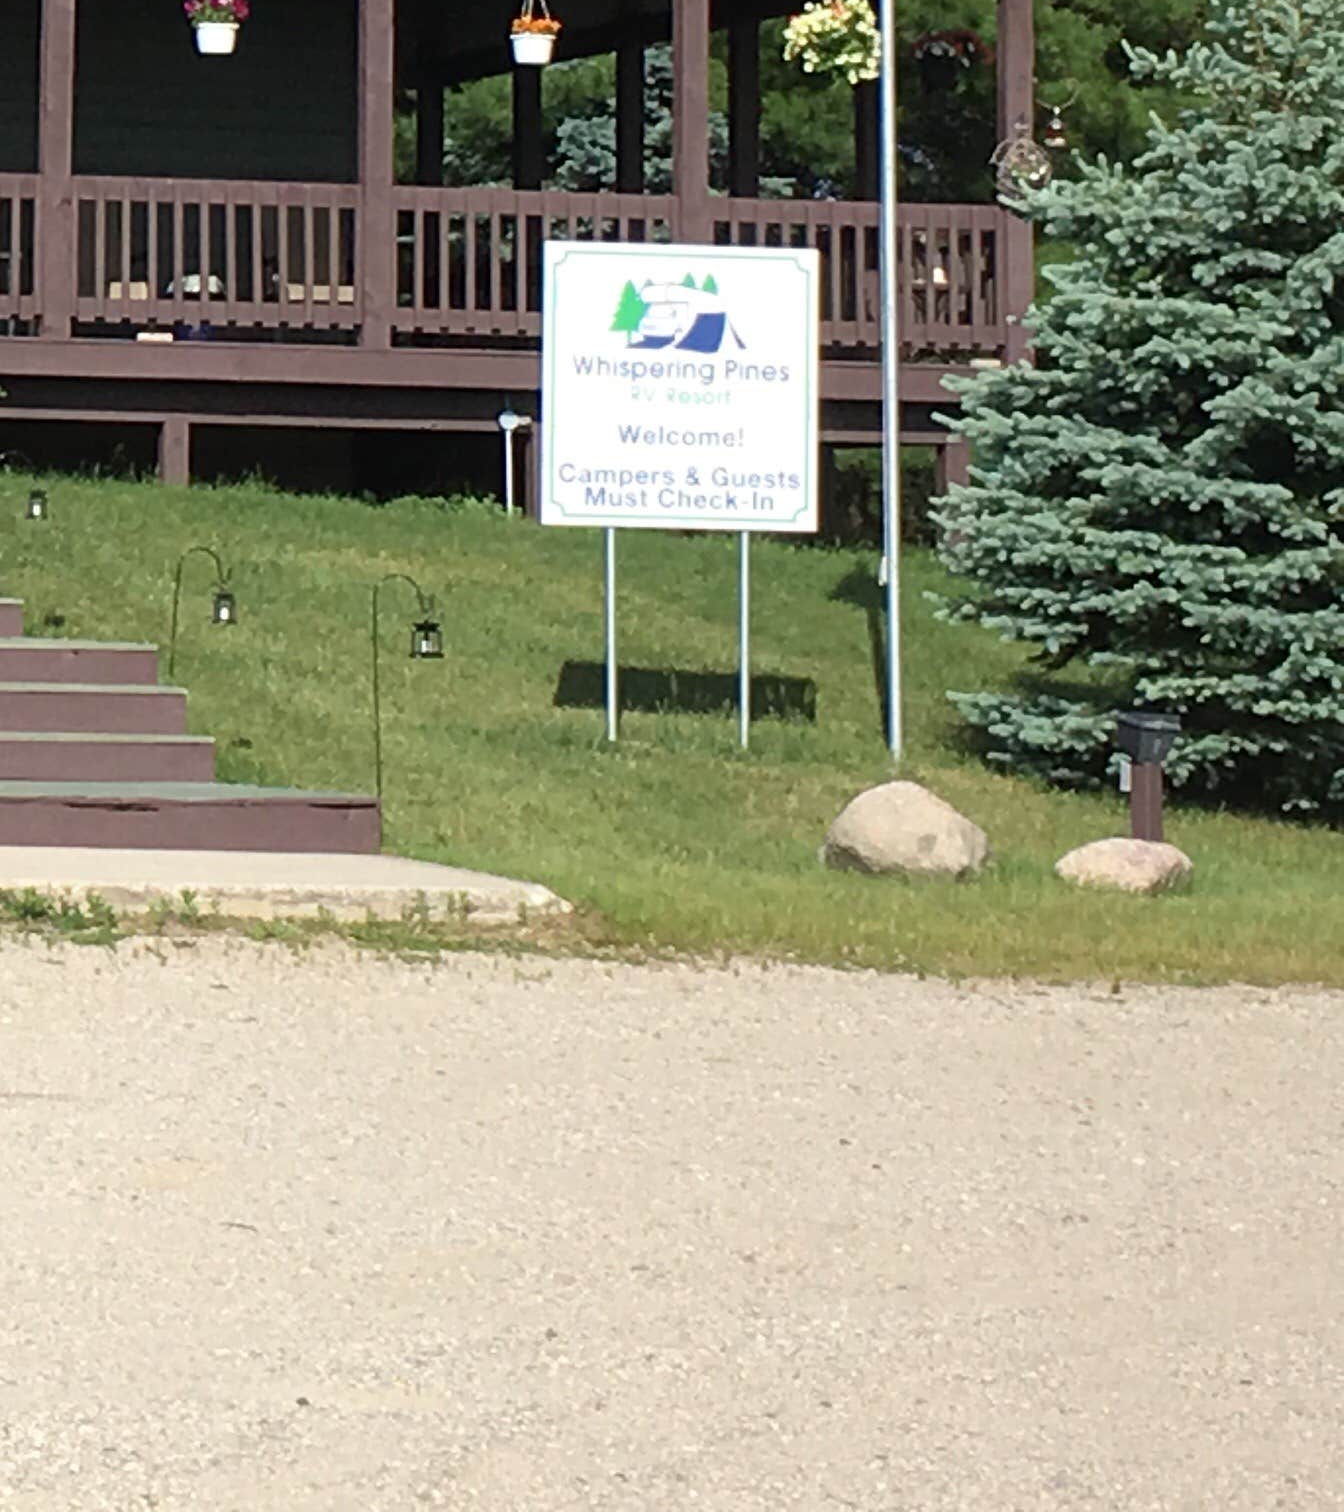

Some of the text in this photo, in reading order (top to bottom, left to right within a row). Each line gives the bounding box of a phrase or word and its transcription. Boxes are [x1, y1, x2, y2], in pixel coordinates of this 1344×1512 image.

[573, 355, 790, 385] Whispering Pines
[631, 385, 732, 405] RV Resort
[617, 424, 745, 448] Welcome!
[558, 462, 801, 489] Campers & Guests
[583, 486, 775, 510] Must Check-In
